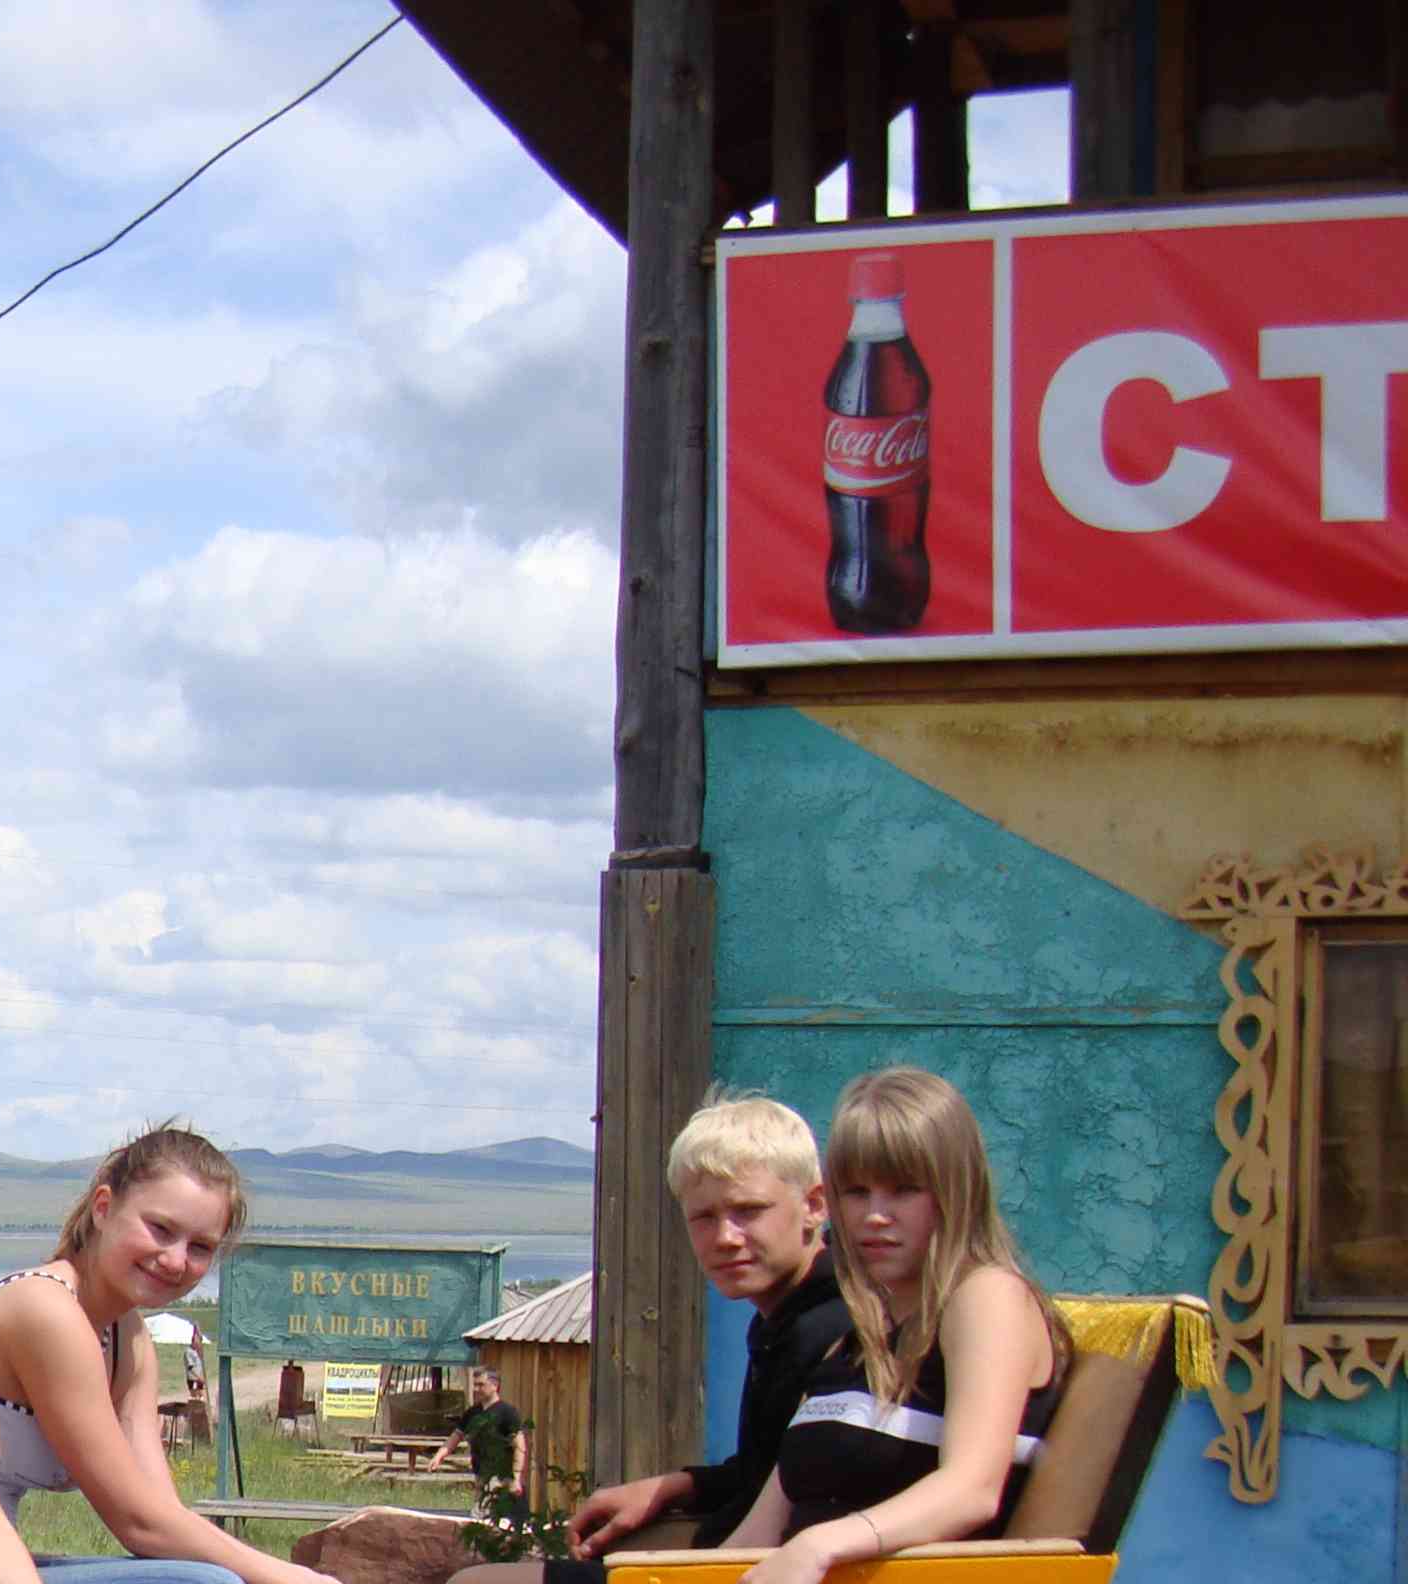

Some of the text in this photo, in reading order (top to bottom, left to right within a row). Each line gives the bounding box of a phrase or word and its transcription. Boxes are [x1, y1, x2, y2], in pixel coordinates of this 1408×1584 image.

[1038, 322, 1408, 533] СТ
[291, 1270, 432, 1299] ВКУСНЫЕ
[288, 1313, 428, 1338] ШАШЛЫКИ
